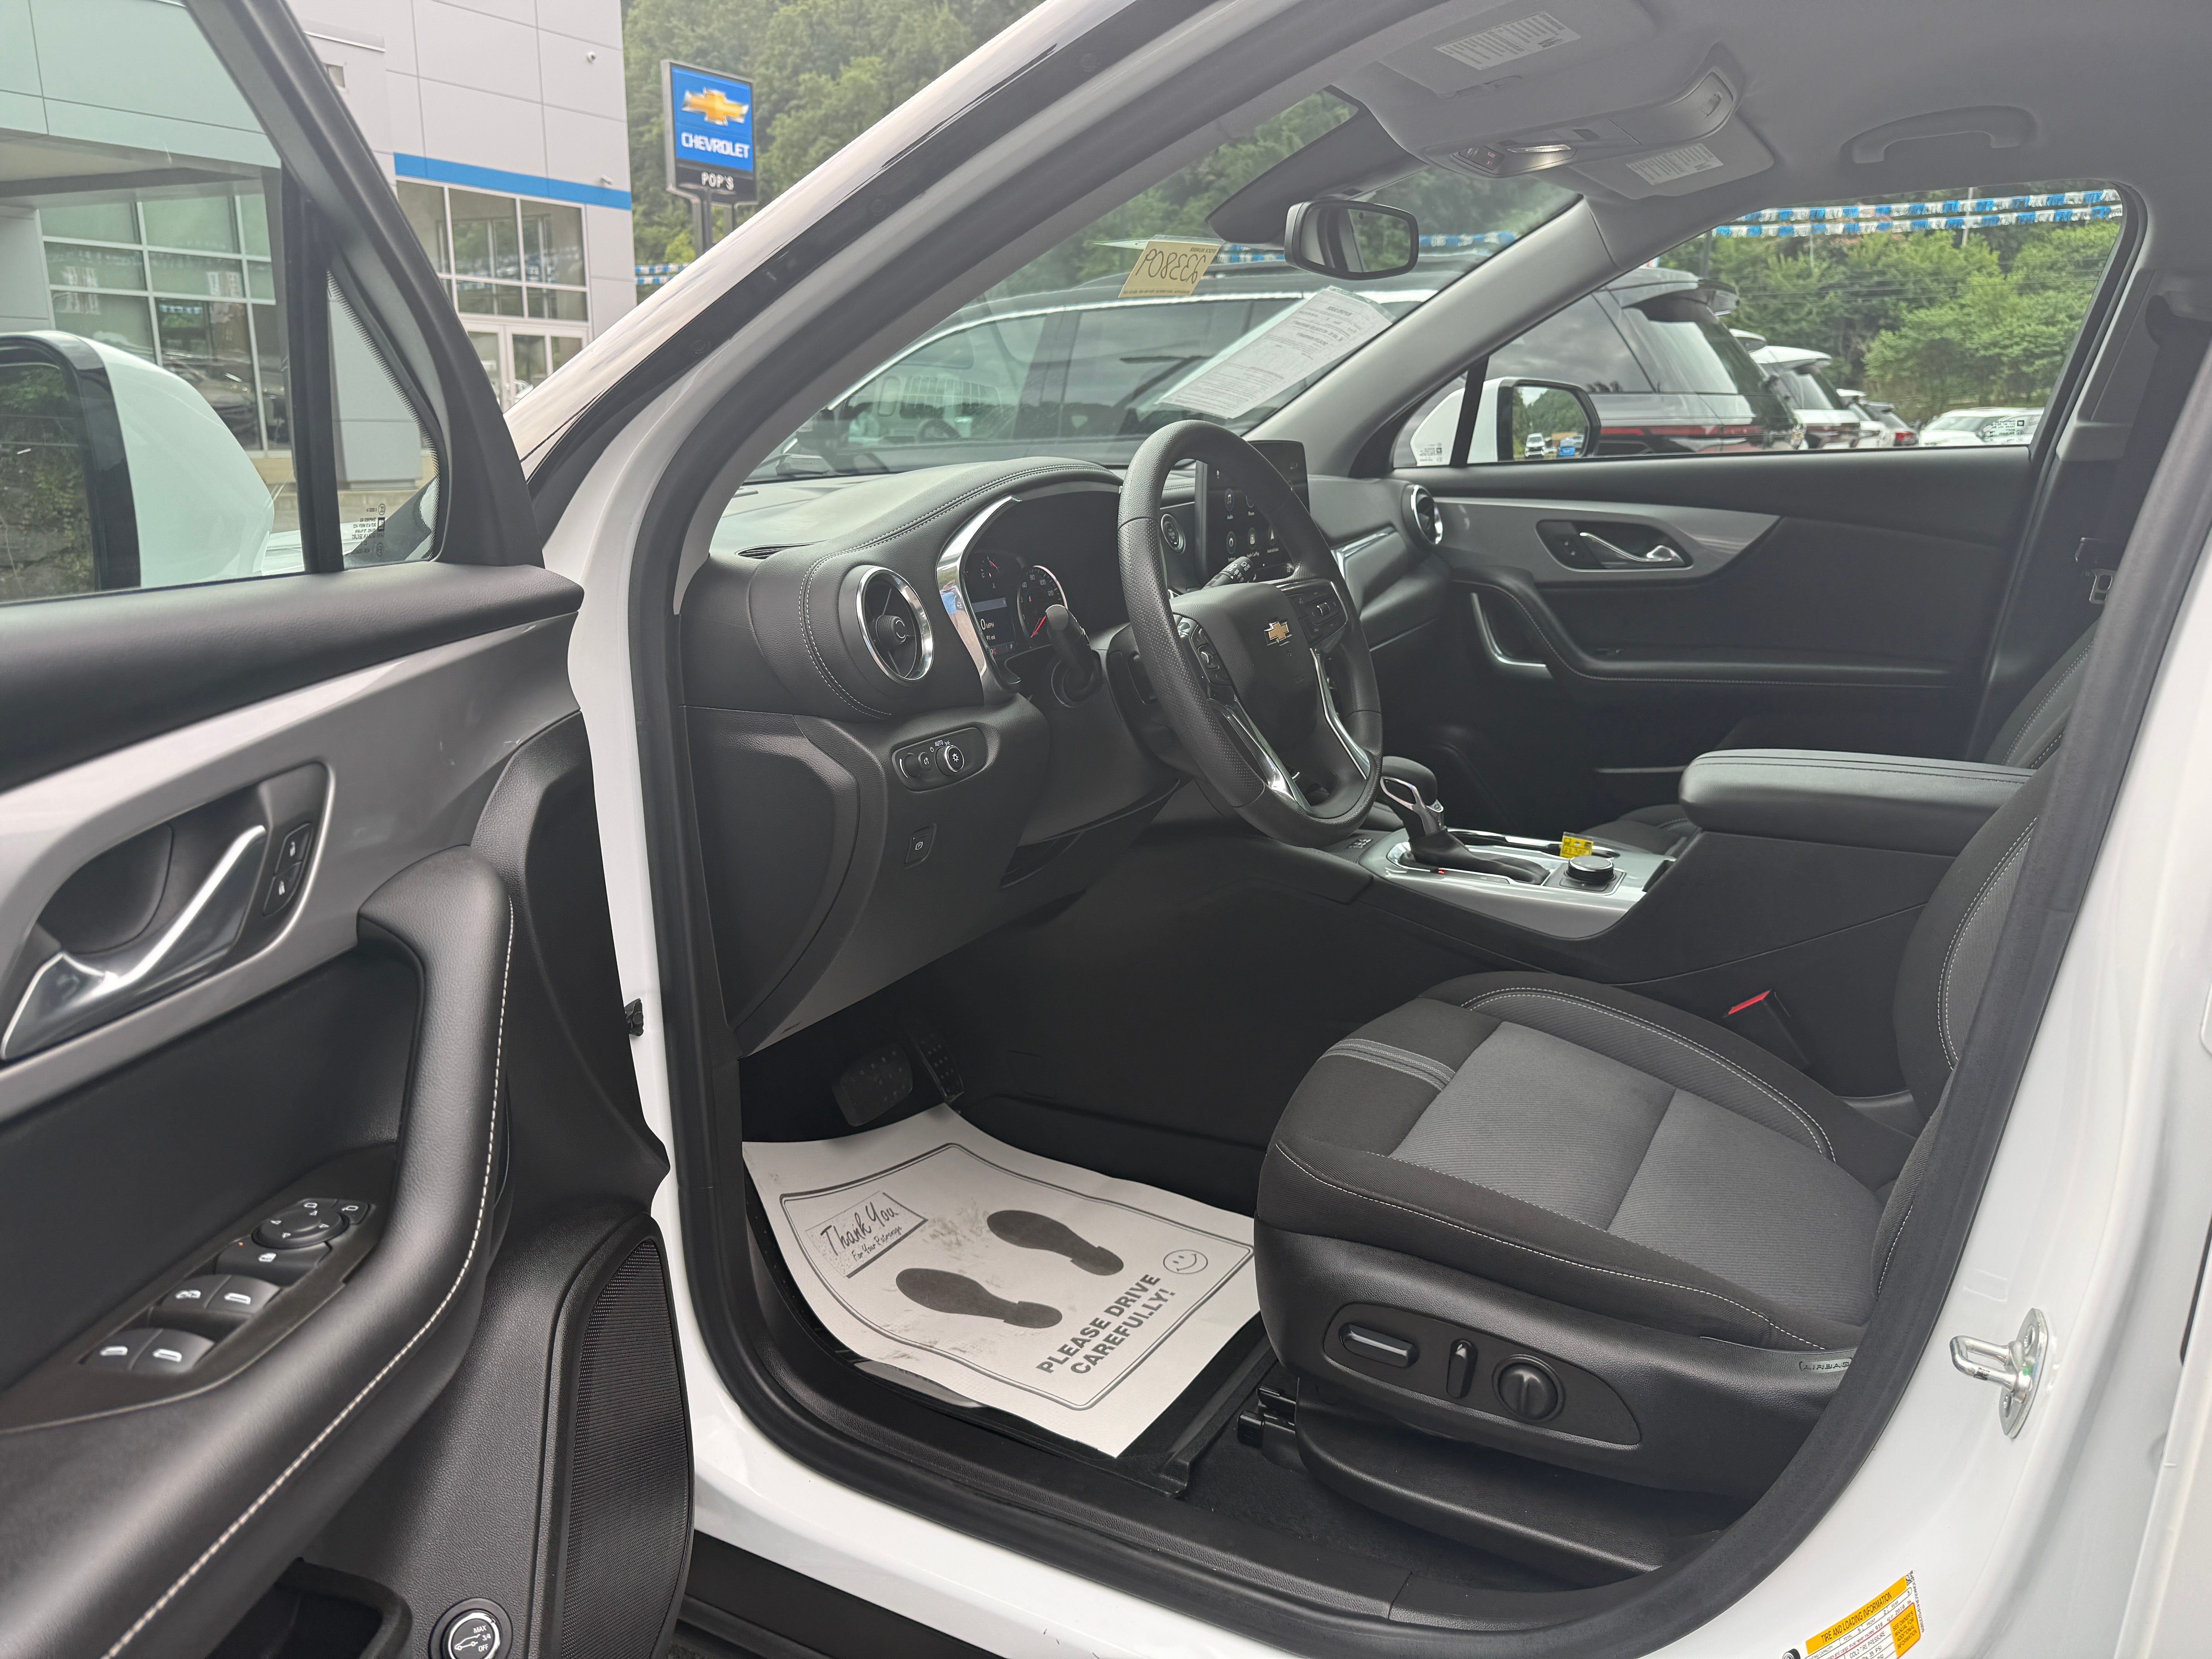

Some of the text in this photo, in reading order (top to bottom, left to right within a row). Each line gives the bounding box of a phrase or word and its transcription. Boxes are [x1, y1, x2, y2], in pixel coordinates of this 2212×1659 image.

[681, 132, 750, 158] CHEVROLET
[701, 172, 734, 191] POP'S
[981, 619, 986, 630] 0
[820, 1201, 899, 1256] Thank You
[852, 1250, 863, 1261] For
[862, 1244, 876, 1254] Your
[1036, 1274, 1161, 1373] PLEASE DRIVE
[1070, 1288, 1176, 1374] CAREFULLY!
[1803, 1362, 1849, 1370] AIRBAG
[1821, 1592, 1892, 1643] TIRE AND LOADING INFORMATION
[474, 1625, 487, 1633] MAX
[1875, 1622, 1883, 1630] 916
[482, 1633, 491, 1641] 3/4
[478, 1644, 488, 1652] OFF
[1850, 1649, 1859, 1659] COLD
